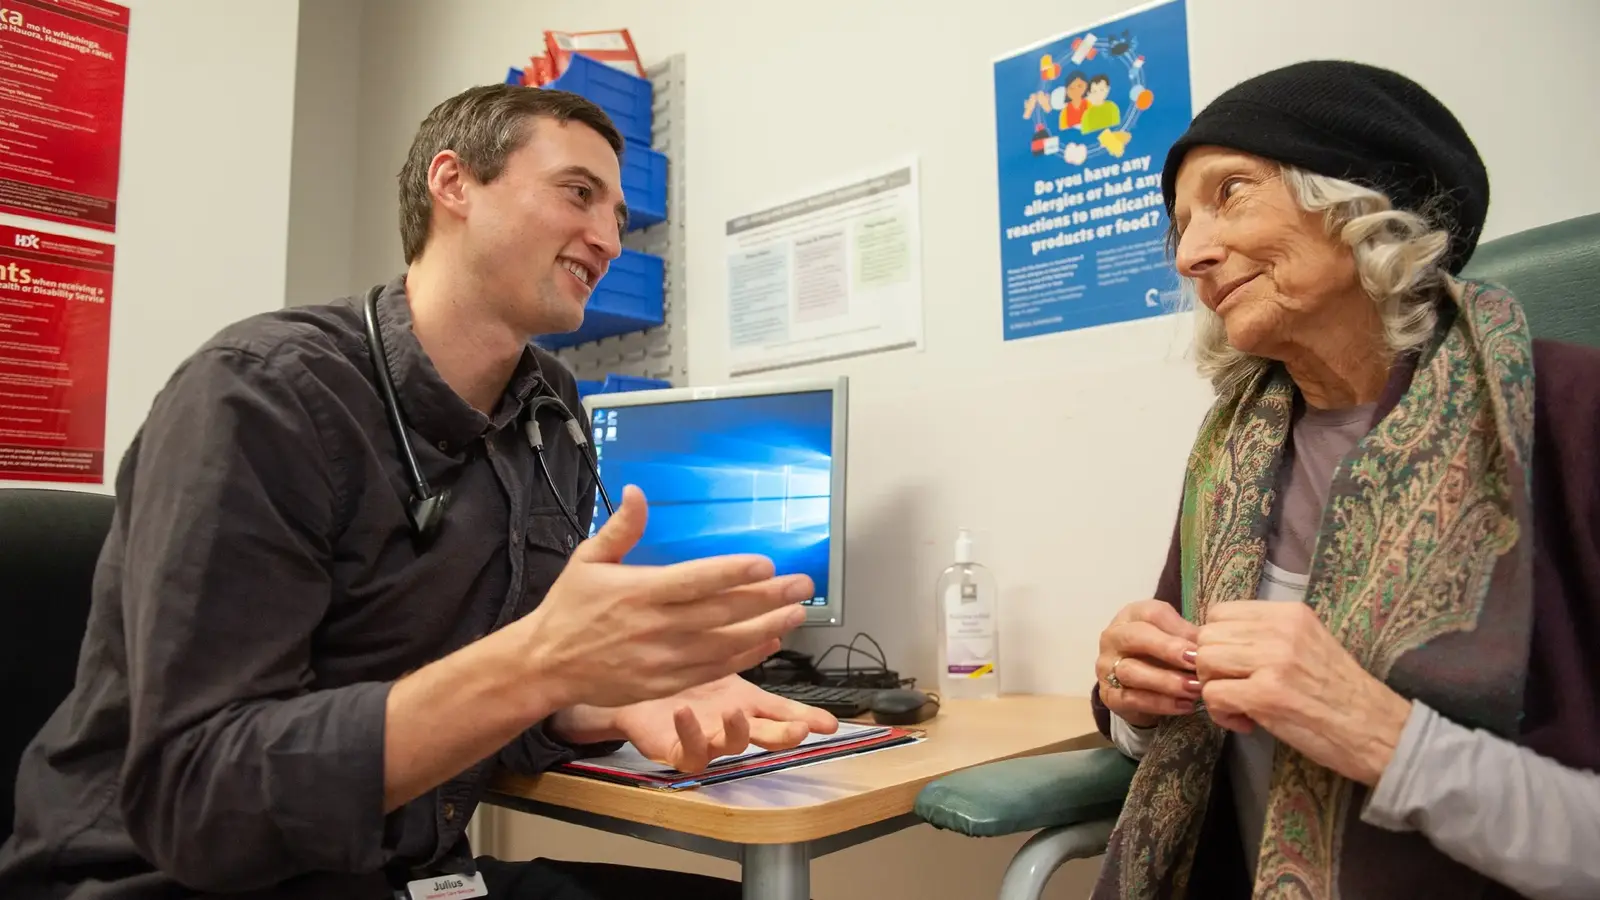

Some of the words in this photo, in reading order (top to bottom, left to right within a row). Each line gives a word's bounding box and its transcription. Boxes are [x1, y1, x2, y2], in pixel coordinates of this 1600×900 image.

[1034, 179, 1054, 196] Do
[1055, 173, 1082, 193] you
[1084, 163, 1120, 183] have
[1121, 155, 1151, 173] any
[1024, 192, 1084, 217] allergies
[1086, 187, 1103, 201] or
[1104, 176, 1133, 197] had
[1135, 172, 1163, 190] any
[1006, 214, 1071, 239] reactions
[1072, 210, 1088, 225] to
[1031, 227, 1095, 256] products
[1096, 224, 1113, 238] or
[1114, 210, 1160, 234] food?
[21, 285, 32, 293] or
[33, 286, 74, 300] Disability
[75, 292, 105, 304] Service
[32, 278, 57, 288] when
[58, 281, 96, 296] receiving
[433, 880, 464, 892] Julius
